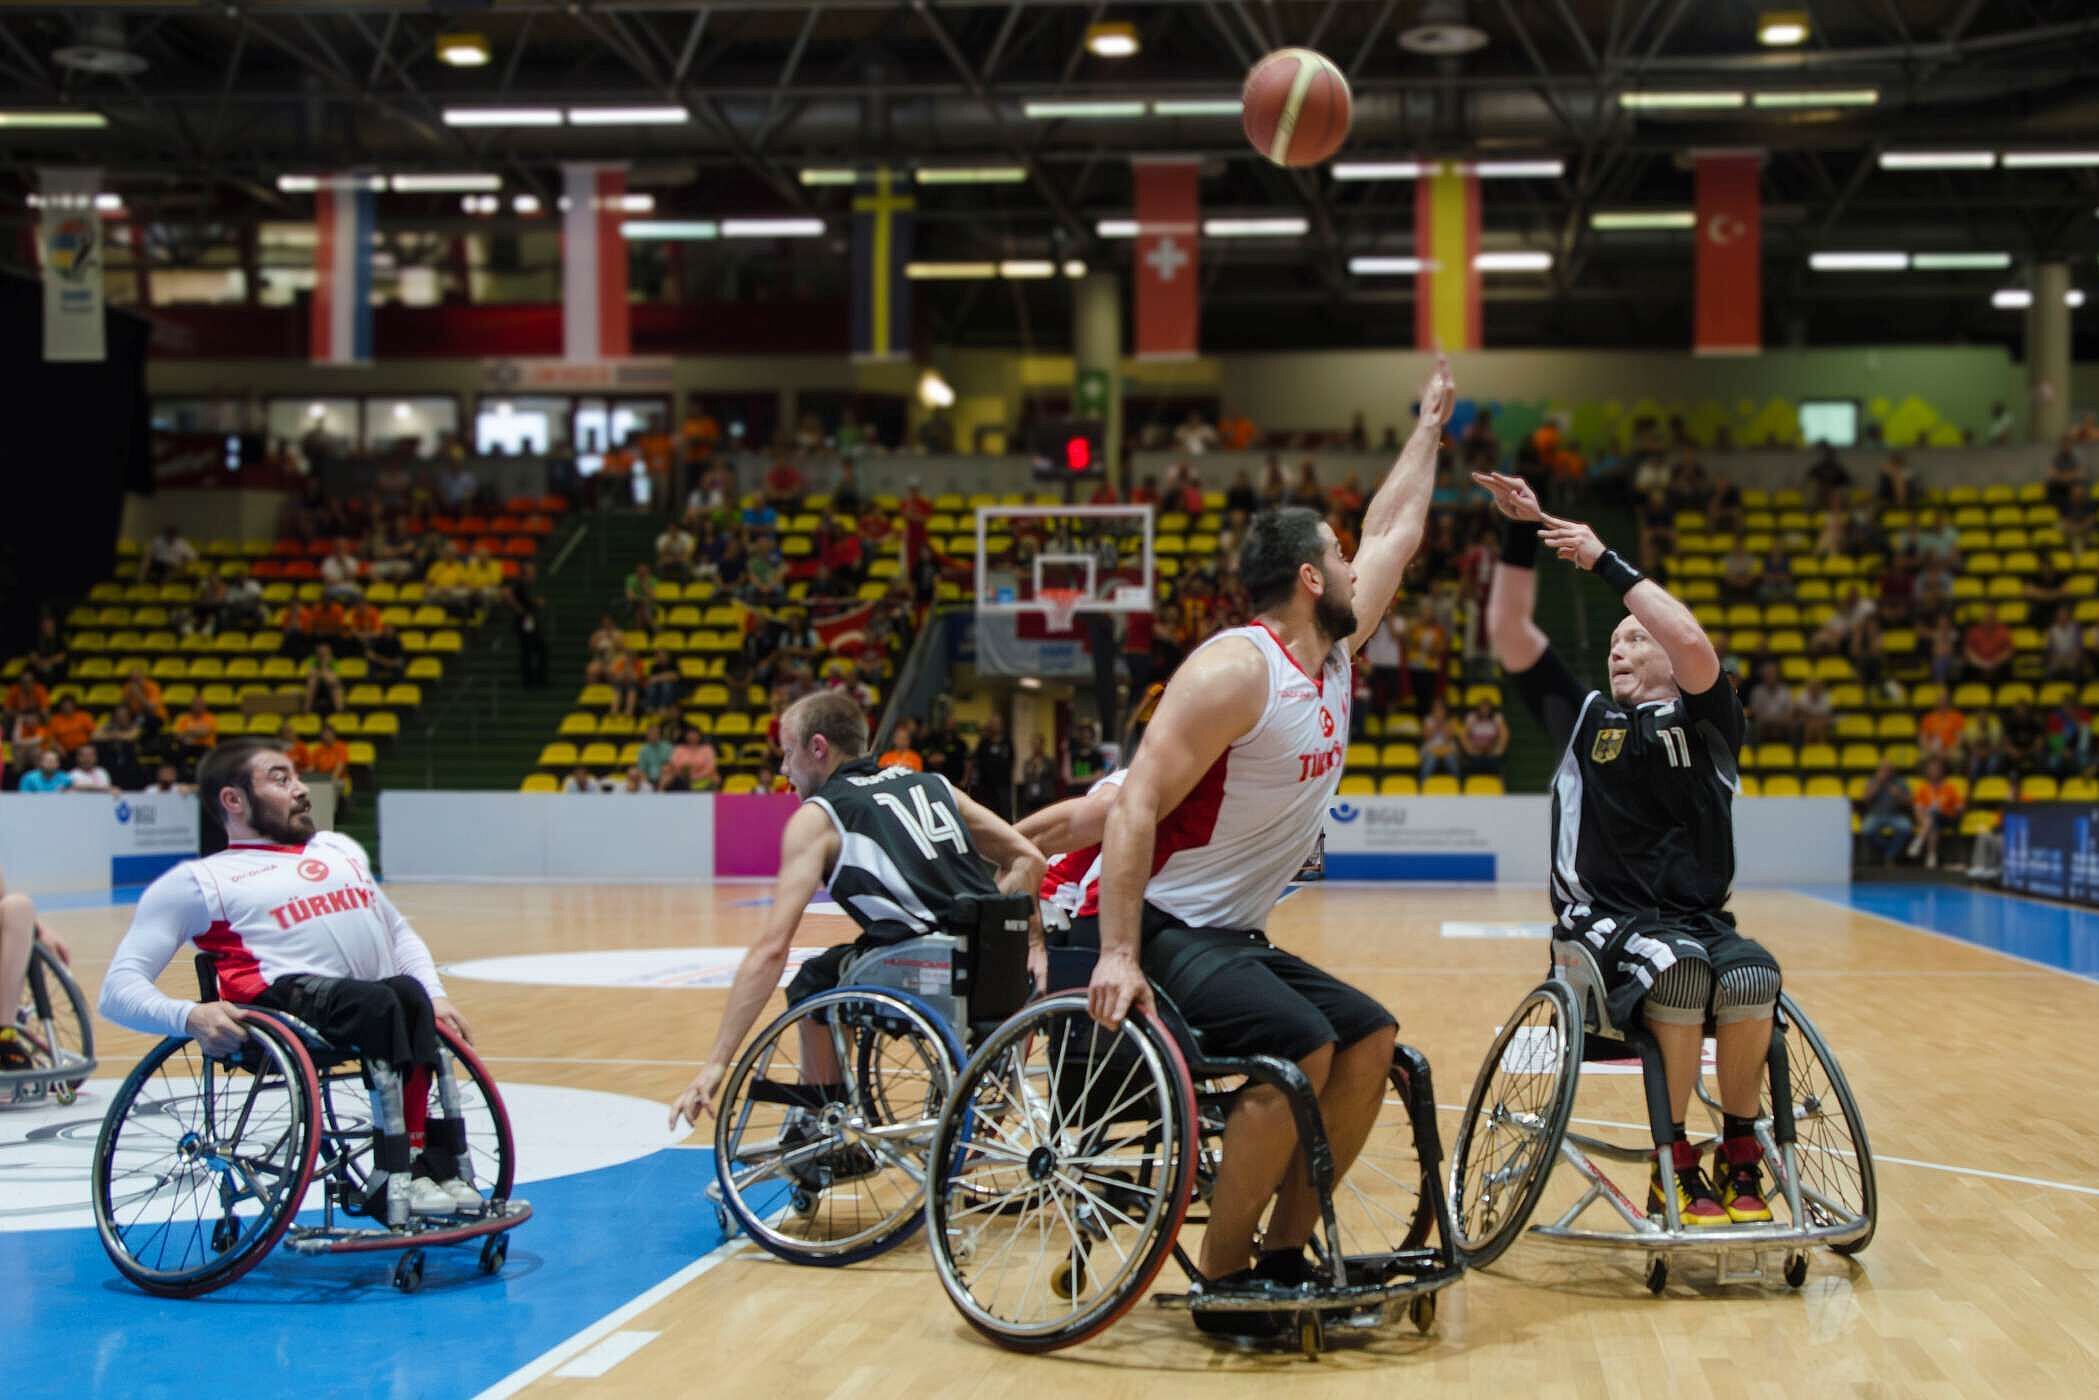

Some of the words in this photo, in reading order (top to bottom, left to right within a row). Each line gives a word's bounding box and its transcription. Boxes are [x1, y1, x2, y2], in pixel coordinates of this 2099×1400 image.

[1656, 726, 1692, 768] 11
[872, 784, 969, 860] 14
[1365, 807, 1406, 826] BGU
